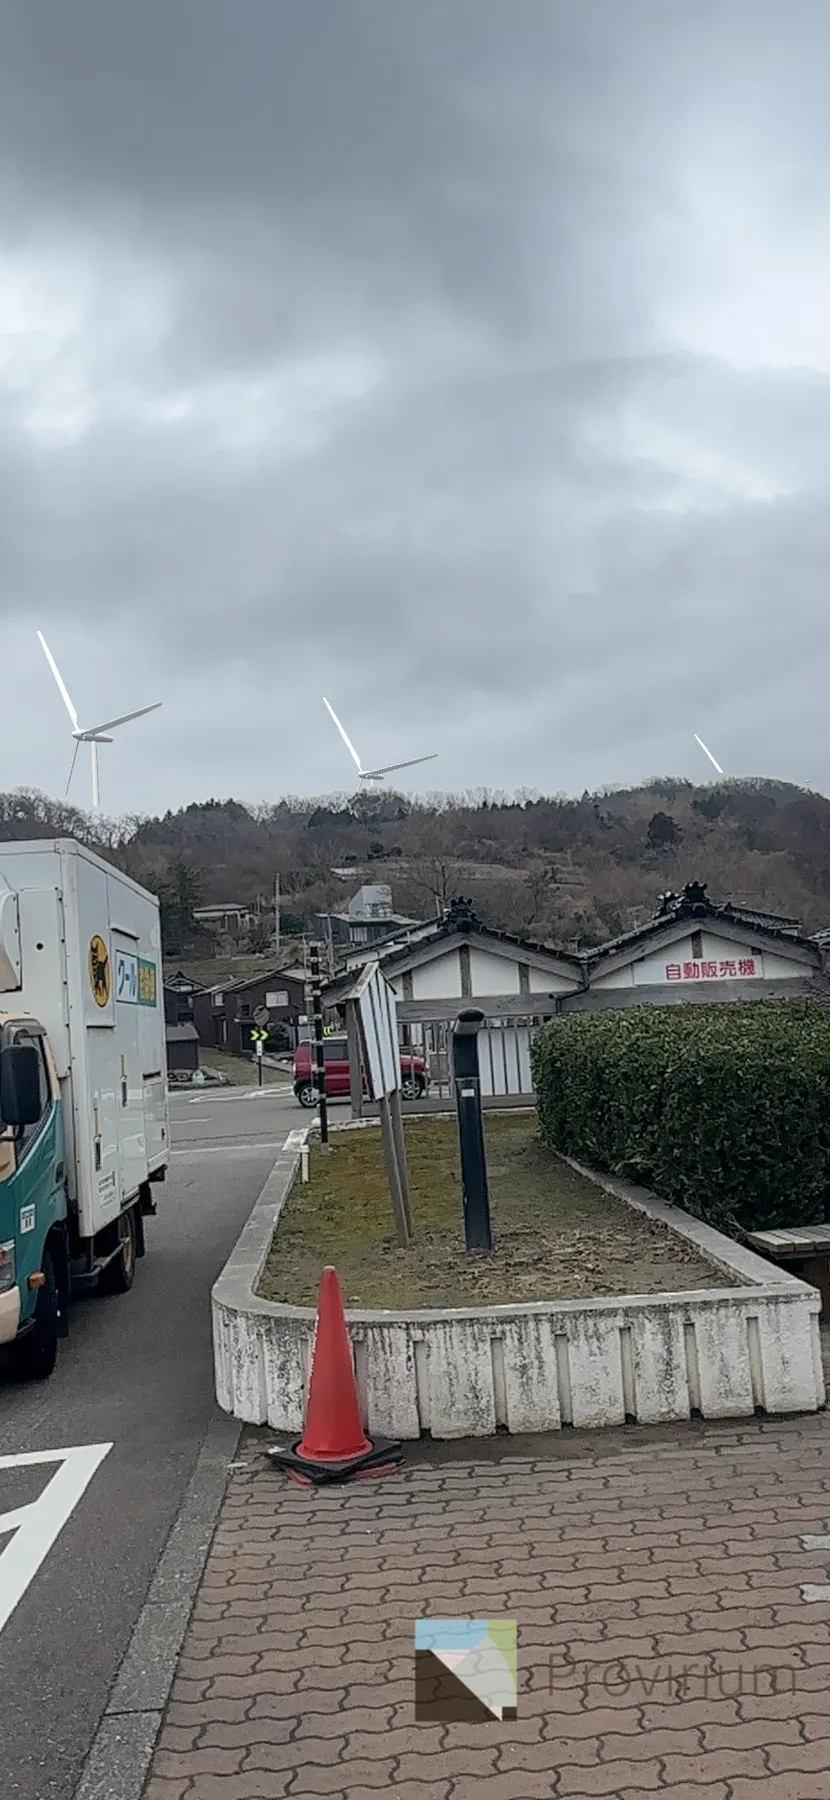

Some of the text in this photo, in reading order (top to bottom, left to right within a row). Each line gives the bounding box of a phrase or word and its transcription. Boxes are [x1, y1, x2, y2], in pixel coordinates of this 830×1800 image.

[665, 958, 756, 980] 自動販売機
